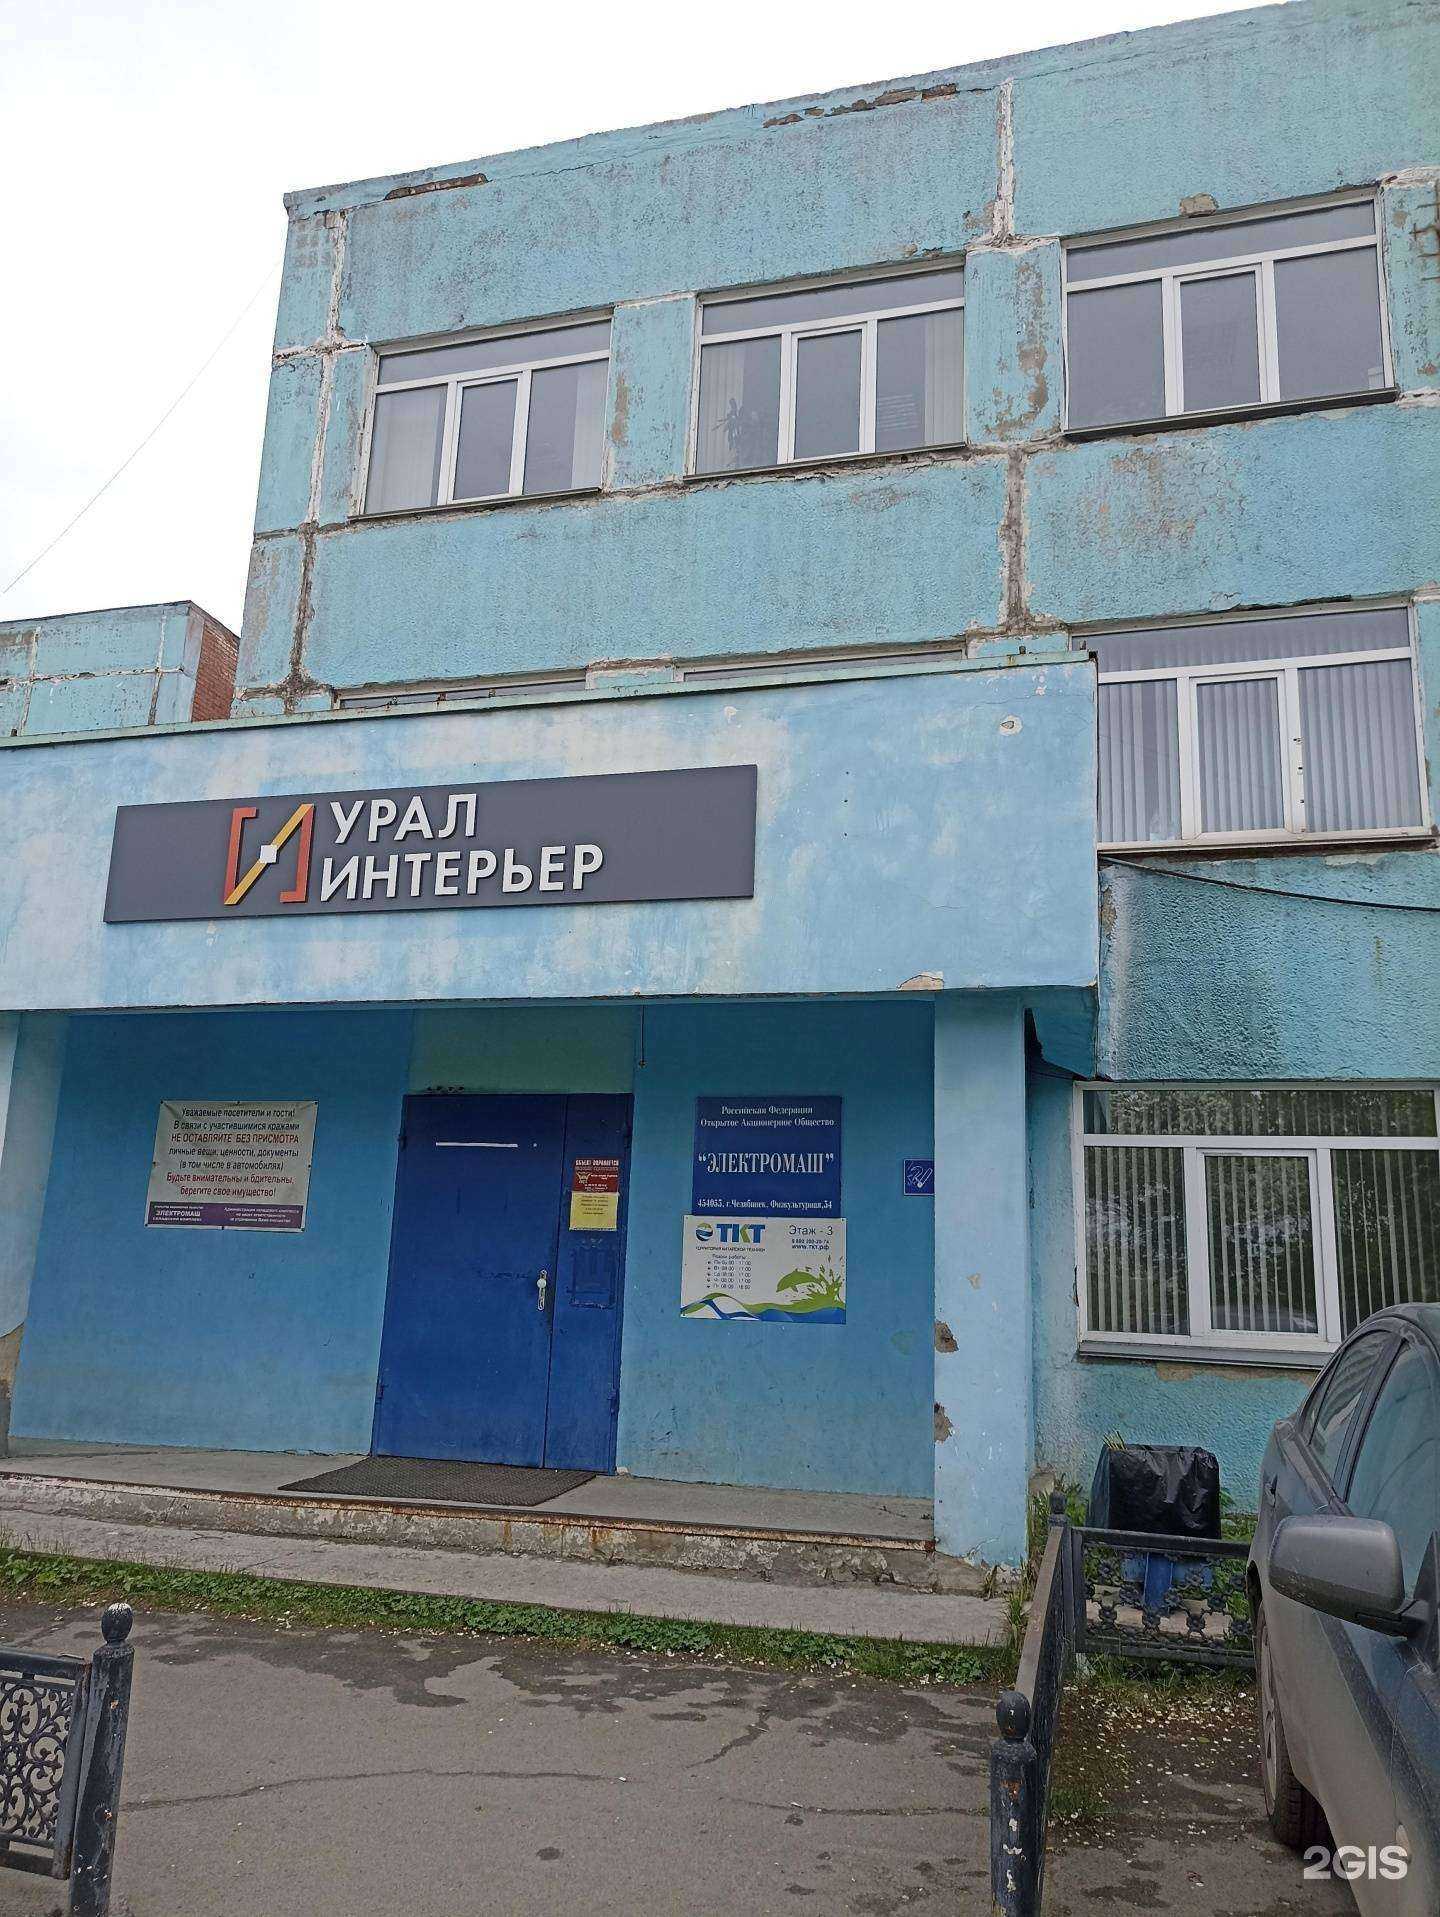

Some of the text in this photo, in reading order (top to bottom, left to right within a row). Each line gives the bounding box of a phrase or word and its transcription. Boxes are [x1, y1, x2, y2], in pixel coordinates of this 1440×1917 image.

[330, 793, 478, 844] УРАЛ
[319, 843, 604, 902] ИНТЕРЬЕР
[182, 1107, 296, 1118] Уважаемые посетители и гости!
[721, 1105, 813, 1115] Российская Федерация
[173, 1120, 179, 1129] В
[180, 1121, 201, 1130] связи
[209, 1121, 266, 1131] участившимися
[267, 1122, 300, 1131] кражами
[700, 1117, 835, 1128] Открытое Акционерное Общество
[171, 1133, 182, 1143] НЕ
[235, 1133, 251, 1143] БЕЗ
[252, 1133, 299, 1144] ПРИСМОТРА
[168, 1148, 196, 1156] личные
[257, 1148, 299, 1158] документы
[188, 1160, 202, 1170] том
[203, 1161, 224, 1170] числе
[232, 1160, 284, 1171] автомобилях)
[166, 1171, 191, 1184] Будьте
[192, 1173, 242, 1183] внимательны
[180, 1185, 211, 1196] берегите
[232, 1187, 276, 1198] имущество!
[716, 1223, 766, 1243] ТКТ
[788, 1225, 817, 1236] Этаж
[827, 1225, 833, 1236] 3
